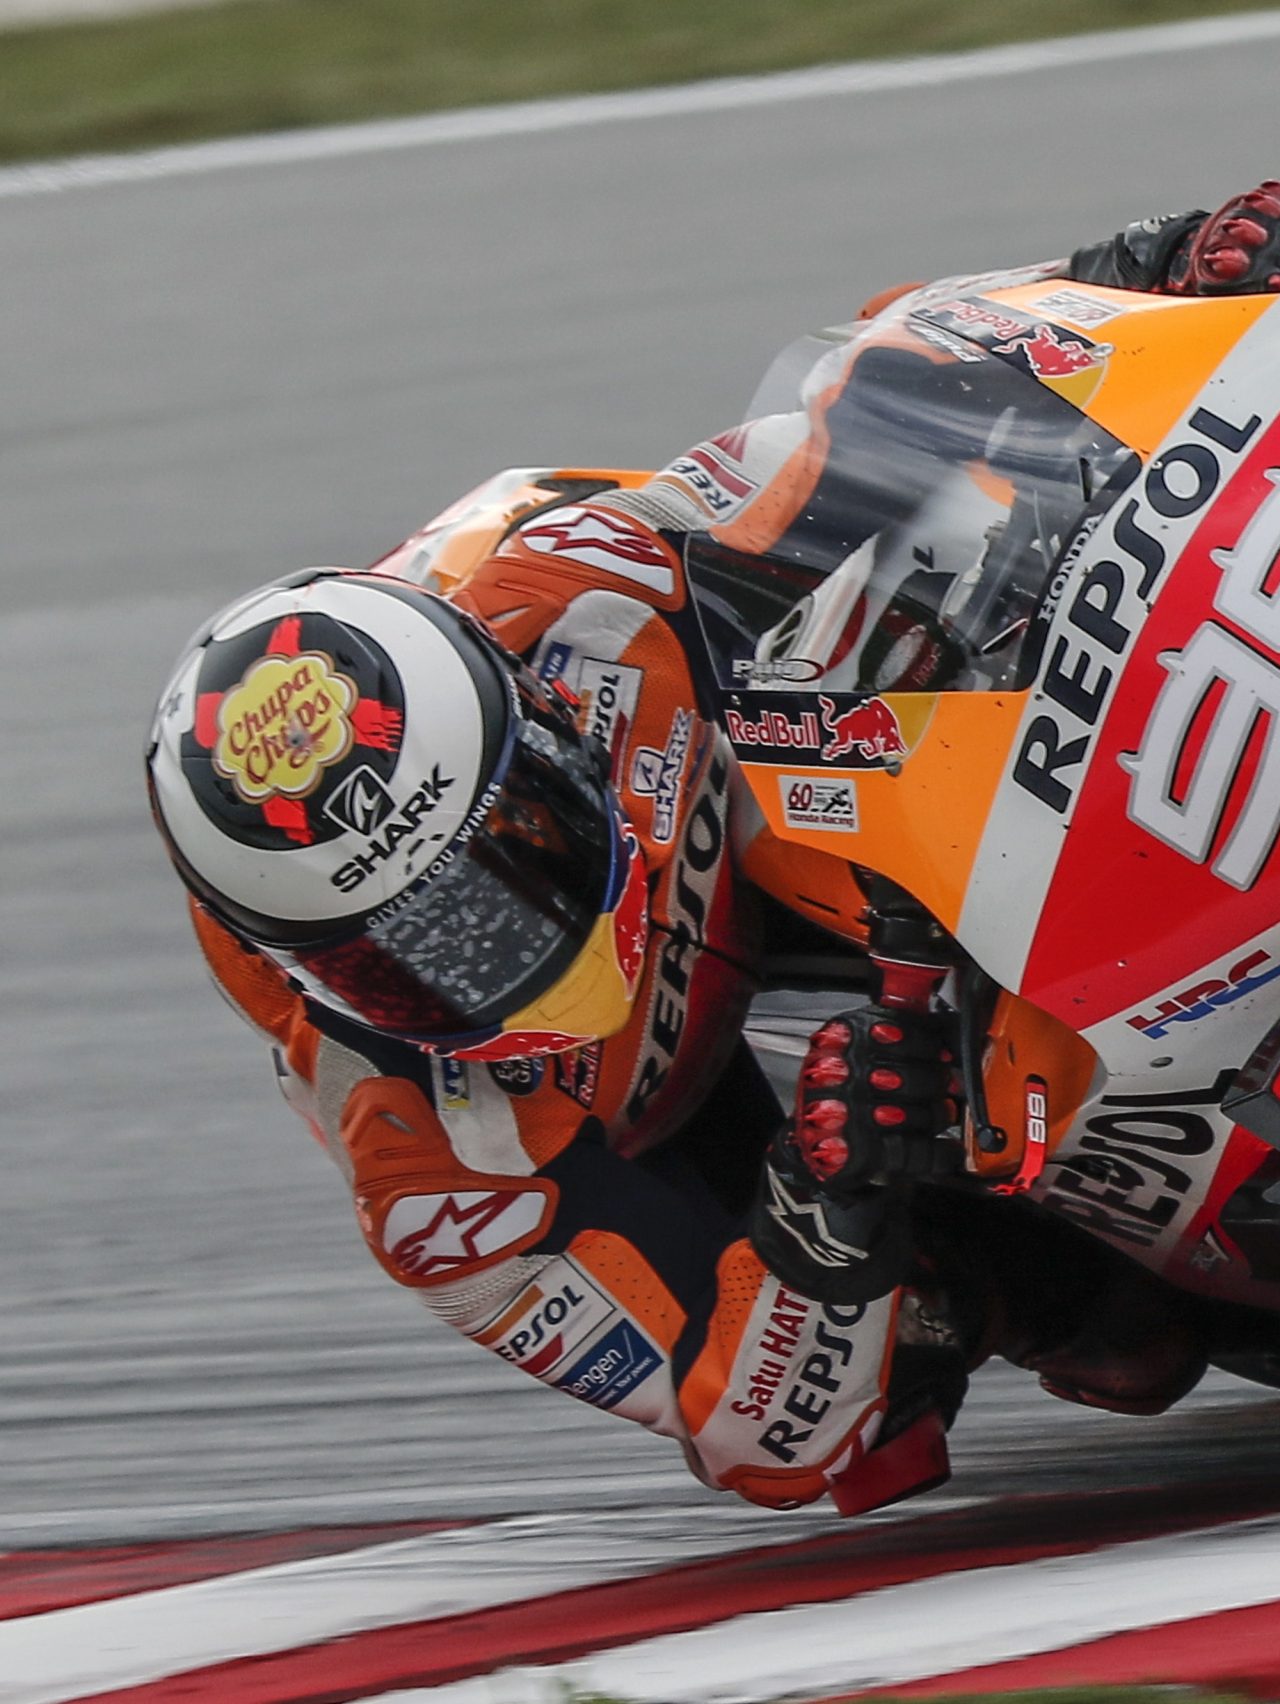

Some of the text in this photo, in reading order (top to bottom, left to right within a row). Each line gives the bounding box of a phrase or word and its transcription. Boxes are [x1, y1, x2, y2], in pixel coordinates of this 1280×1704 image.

[1012, 407, 1262, 814] REPSOL
[1038, 513, 1104, 624] HONDA
[229, 665, 313, 756] Chupa
[330, 762, 456, 893] SHARK
[656, 708, 697, 842] SHARK
[788, 783, 812, 807] 60
[365, 781, 502, 930] GIVES YOU WINGS
[1042, 1068, 1242, 1248] REPSOL
[560, 1348, 623, 1396] engen
[731, 1359, 787, 1421] Satu
